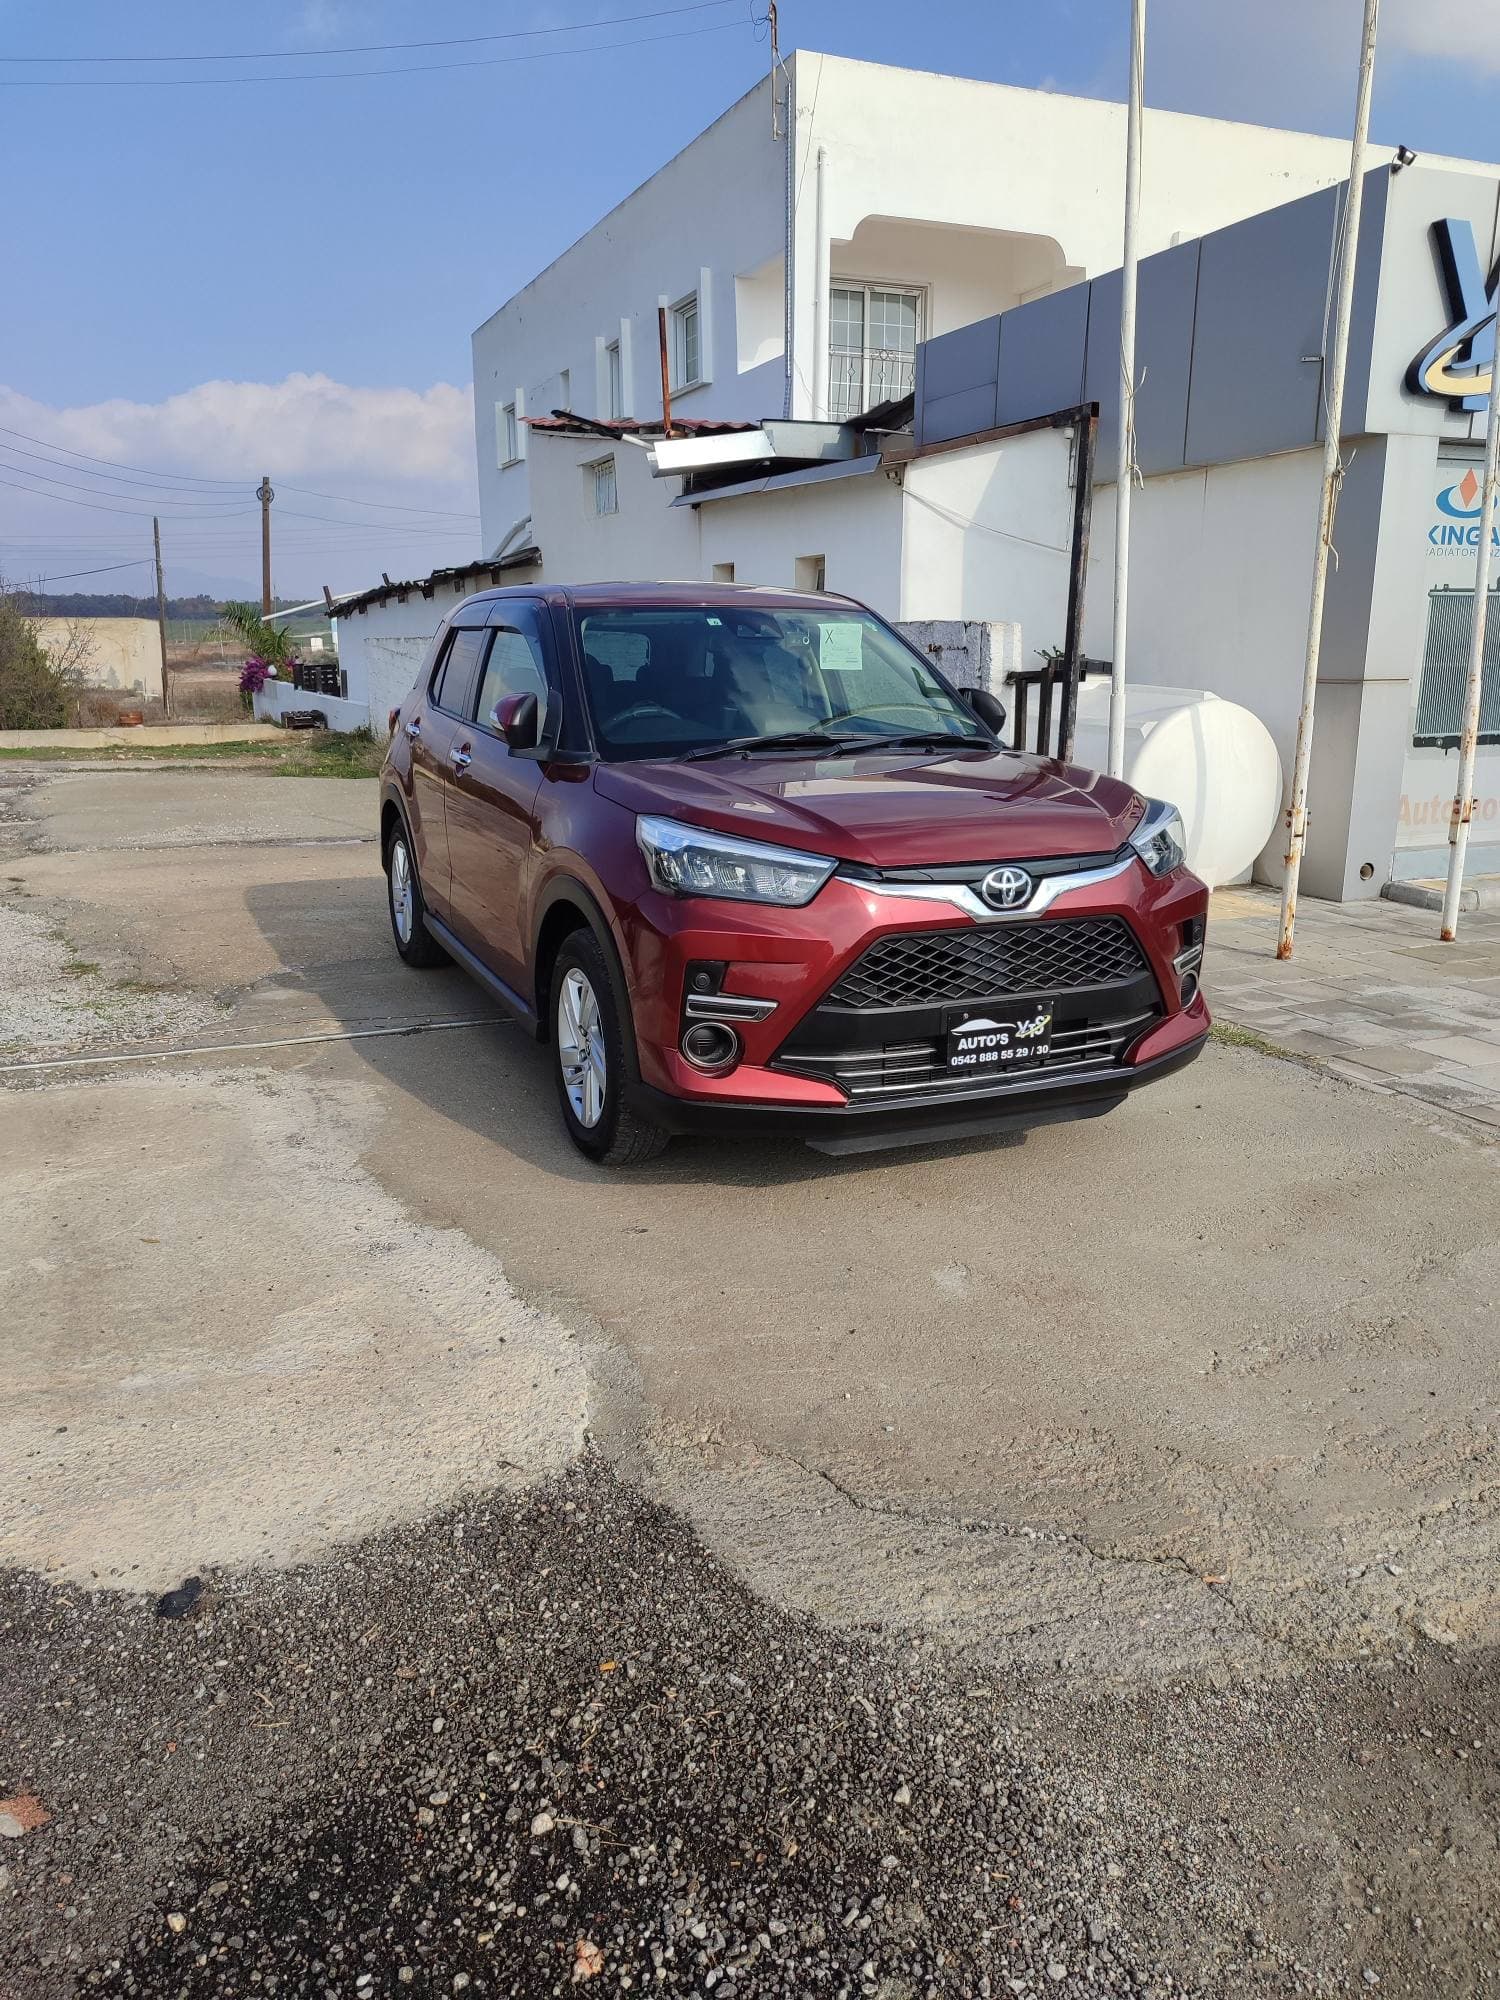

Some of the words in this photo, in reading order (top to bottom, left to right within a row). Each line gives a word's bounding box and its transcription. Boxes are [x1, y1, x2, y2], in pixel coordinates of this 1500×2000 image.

[958, 1034, 1009, 1050] AUTO'S
[951, 1054, 977, 1066] 0542
[979, 1051, 998, 1062] 888
[1000, 1049, 1014, 1059] 55
[1015, 1047, 1029, 1058] 29
[1036, 1044, 1049, 1055] 30
